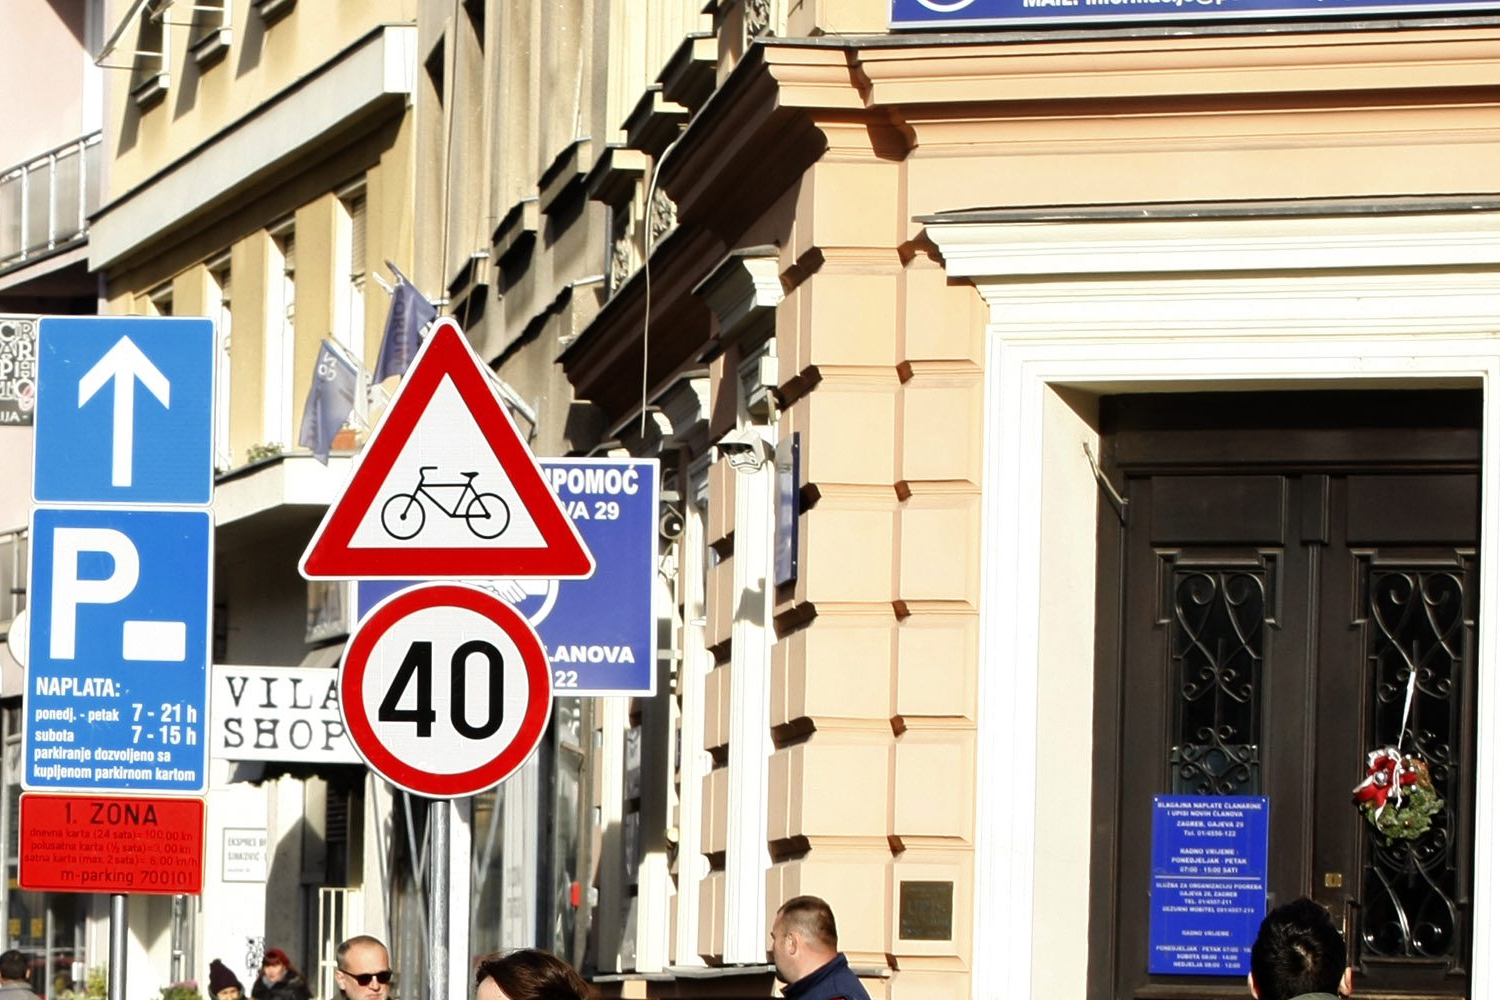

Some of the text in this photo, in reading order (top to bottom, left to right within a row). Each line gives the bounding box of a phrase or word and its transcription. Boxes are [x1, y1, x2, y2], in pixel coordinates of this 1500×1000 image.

[544, 465, 639, 495] IPOMOĆ
[594, 501, 620, 520] 29
[50, 527, 140, 660] P
[36, 676, 121, 697] NAPLATA:
[225, 676, 340, 710] VILA
[378, 640, 505, 740] 40
[35, 707, 77, 723] ponedj.
[88, 708, 120, 723] petak
[131, 703, 143, 722] 7
[160, 703, 182, 723] 21
[186, 705, 197, 723] h
[35, 729, 75, 743] subota
[131, 725, 143, 744] 7
[159, 725, 182, 745] 15
[186, 727, 197, 745] h
[224, 717, 346, 751] SHOP
[34, 747, 171, 763] parkiranje dozvoljeno sa
[34, 764, 196, 782] kupljenom parkirnom kartom
[65, 802, 159, 826] 1. ZONA
[29, 829, 63, 838] dnevna
[66, 829, 90, 838] karta
[31, 841, 77, 852] polusatna
[78, 842, 104, 852] karta
[25, 854, 50, 863] satna
[53, 854, 77, 864] karta
[60, 868, 193, 886] m-parking 700101
